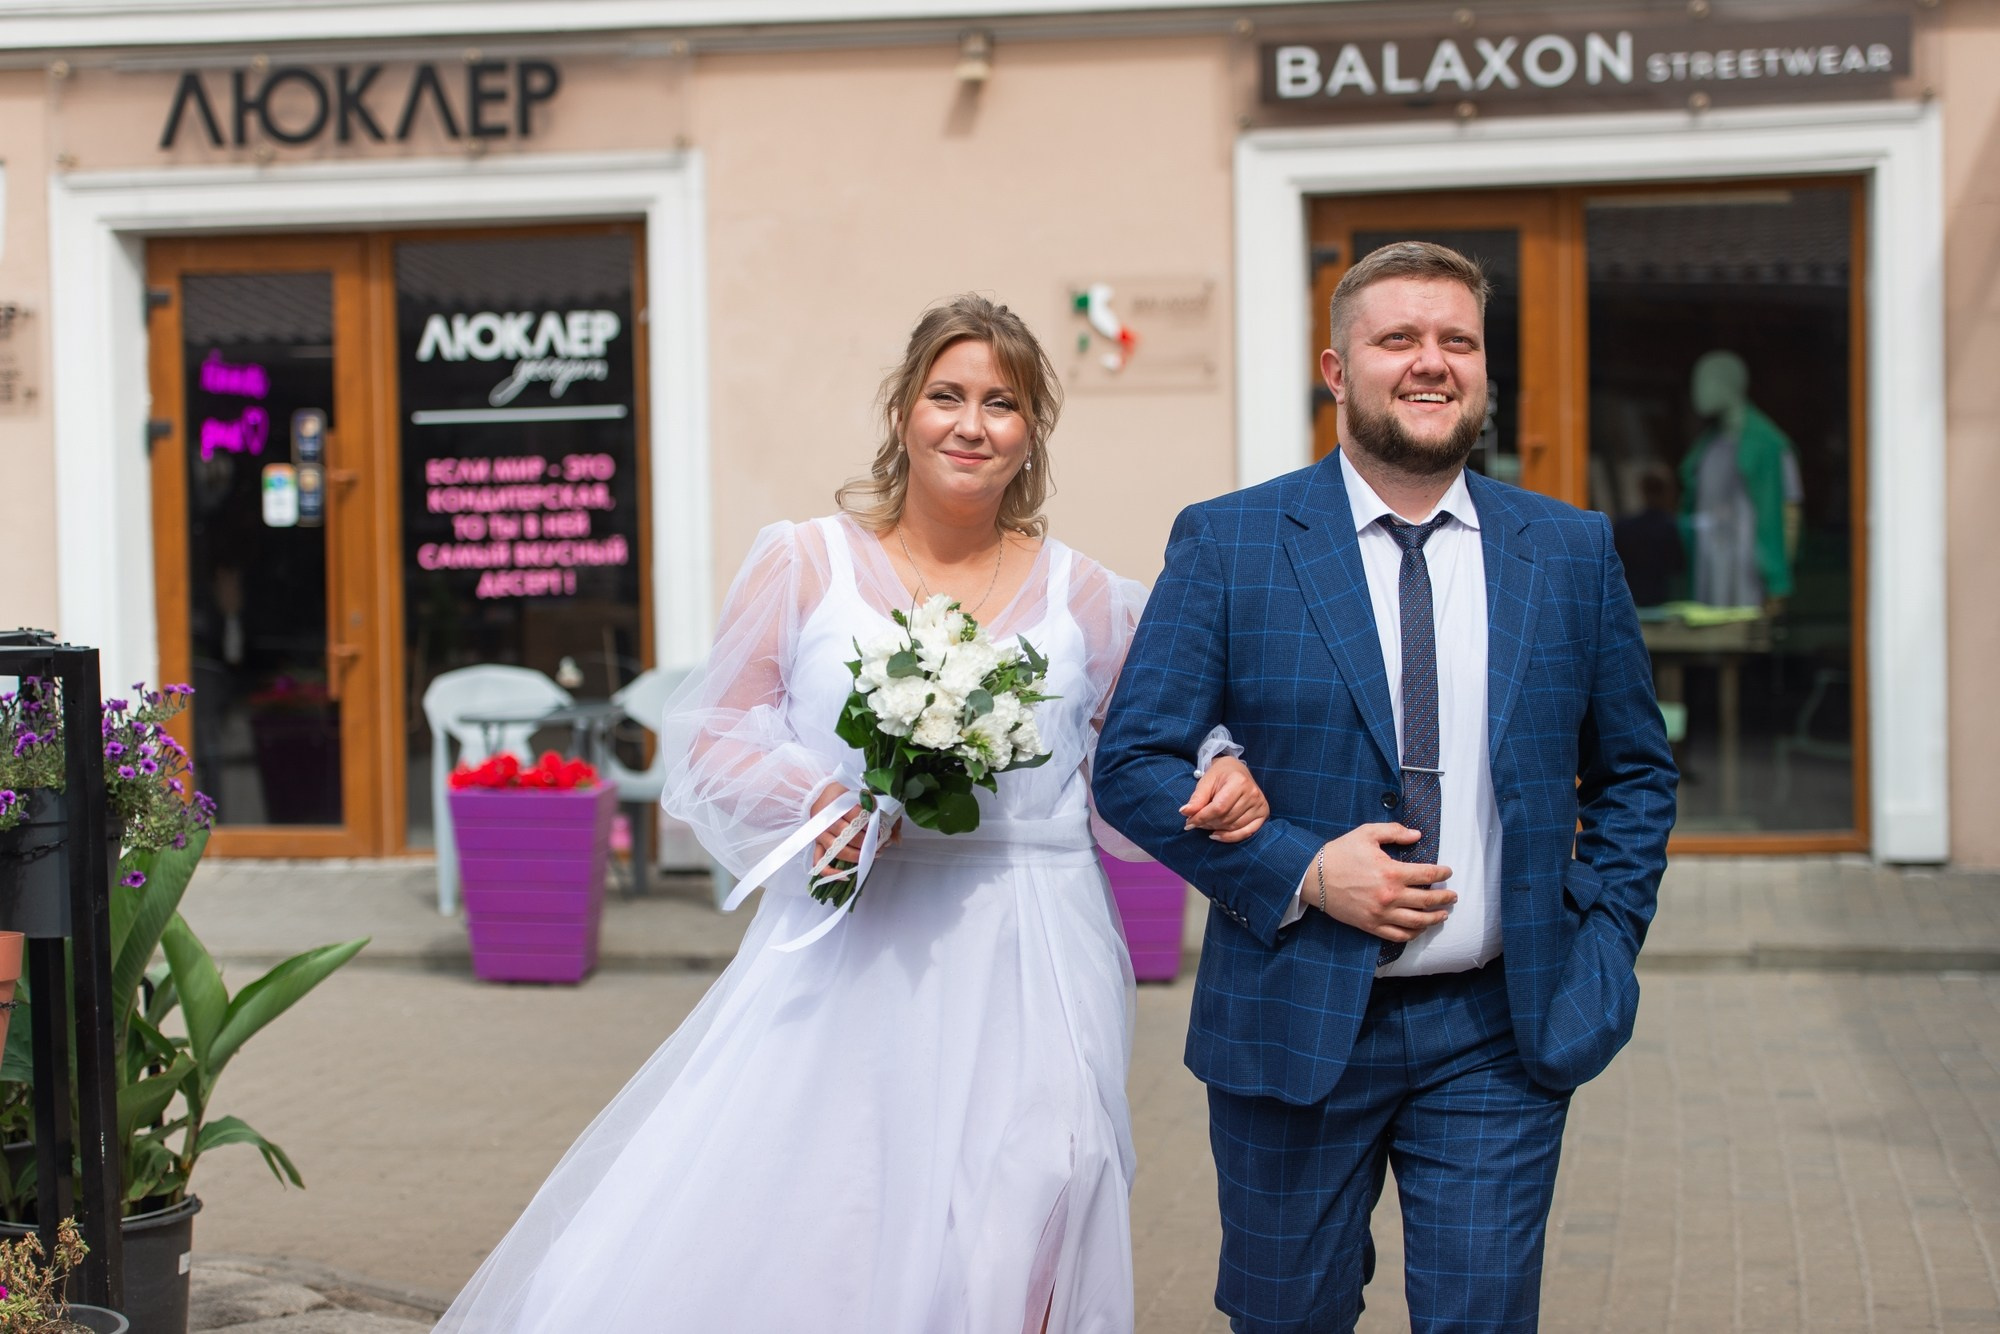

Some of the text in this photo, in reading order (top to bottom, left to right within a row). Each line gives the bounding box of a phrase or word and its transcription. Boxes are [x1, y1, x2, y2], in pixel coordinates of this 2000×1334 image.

[1275, 30, 1893, 99] BALAXON STREETWEAR
[160, 59, 560, 149] ЛЮКЛЕР
[416, 310, 620, 362] ЛЮКЛЕР
[425, 457, 491, 485] ЕСЛИ
[492, 455, 547, 483] МИР
[562, 453, 615, 481] ЭТО
[452, 507, 591, 541] ТО ТЫ В НЕЙ
[417, 534, 628, 570] САМЫЙ ВКУСНЫЙ
